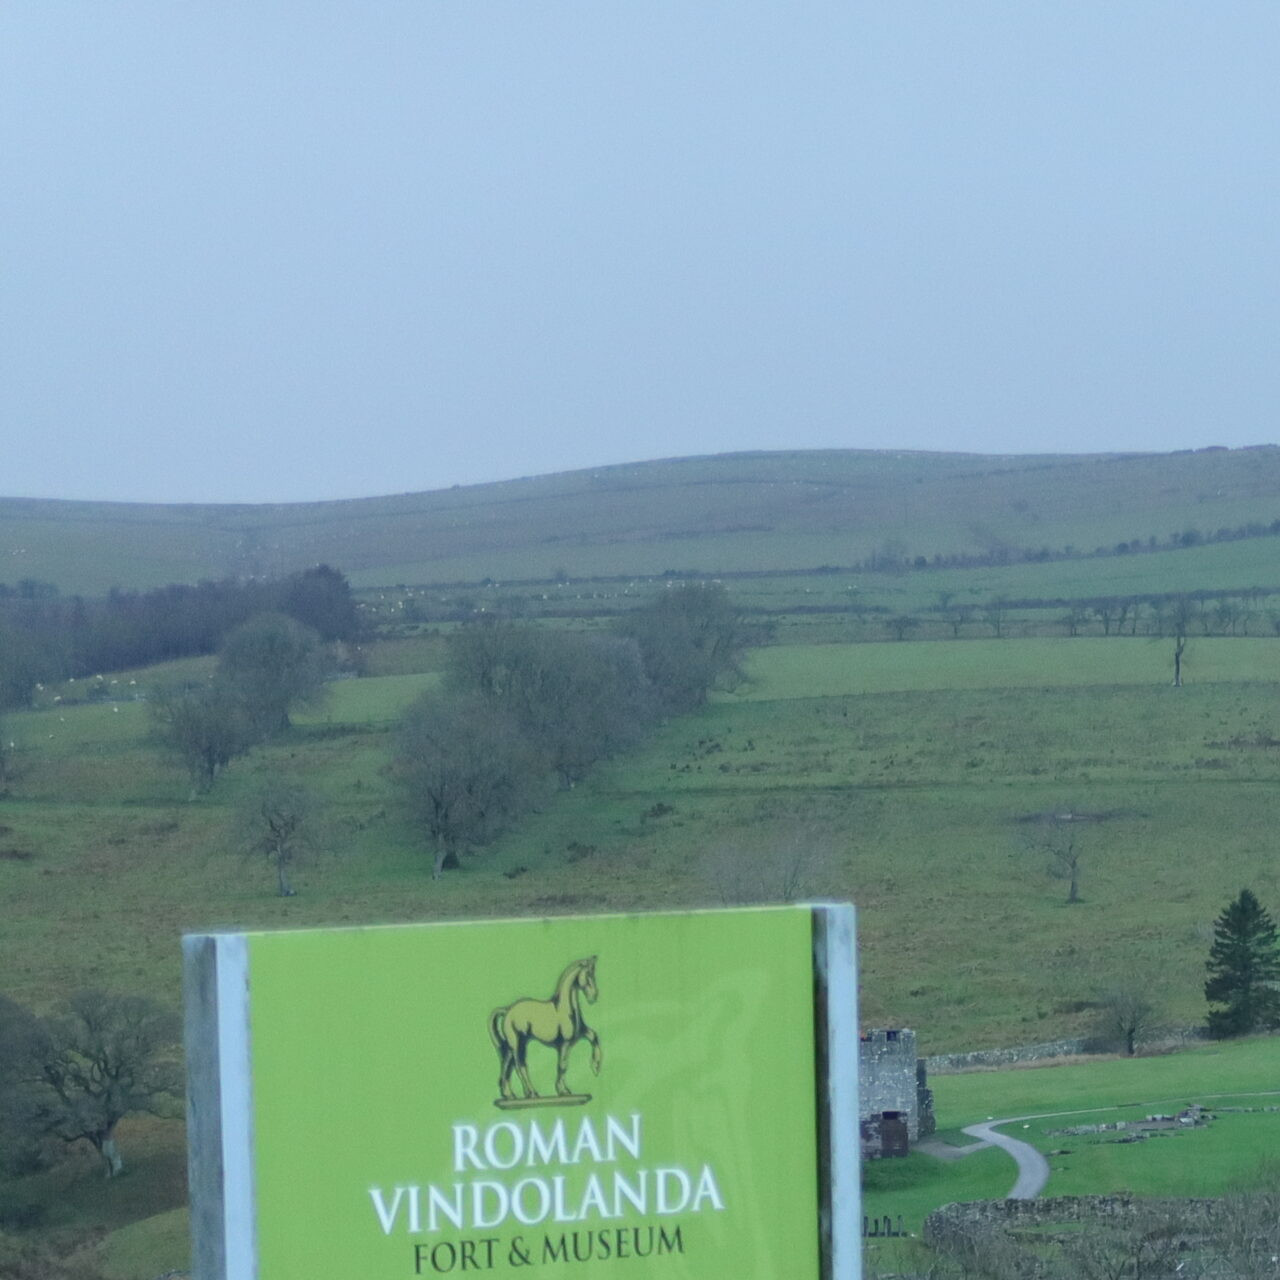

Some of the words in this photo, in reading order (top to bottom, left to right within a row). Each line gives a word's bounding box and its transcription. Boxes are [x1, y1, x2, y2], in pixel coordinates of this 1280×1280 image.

[452, 1113, 641, 1172] ROMAN
[368, 1163, 725, 1236] VINDOLANDA
[413, 1238, 500, 1275] FORT
[508, 1235, 532, 1268] &
[542, 1224, 686, 1265] MUSEUM
